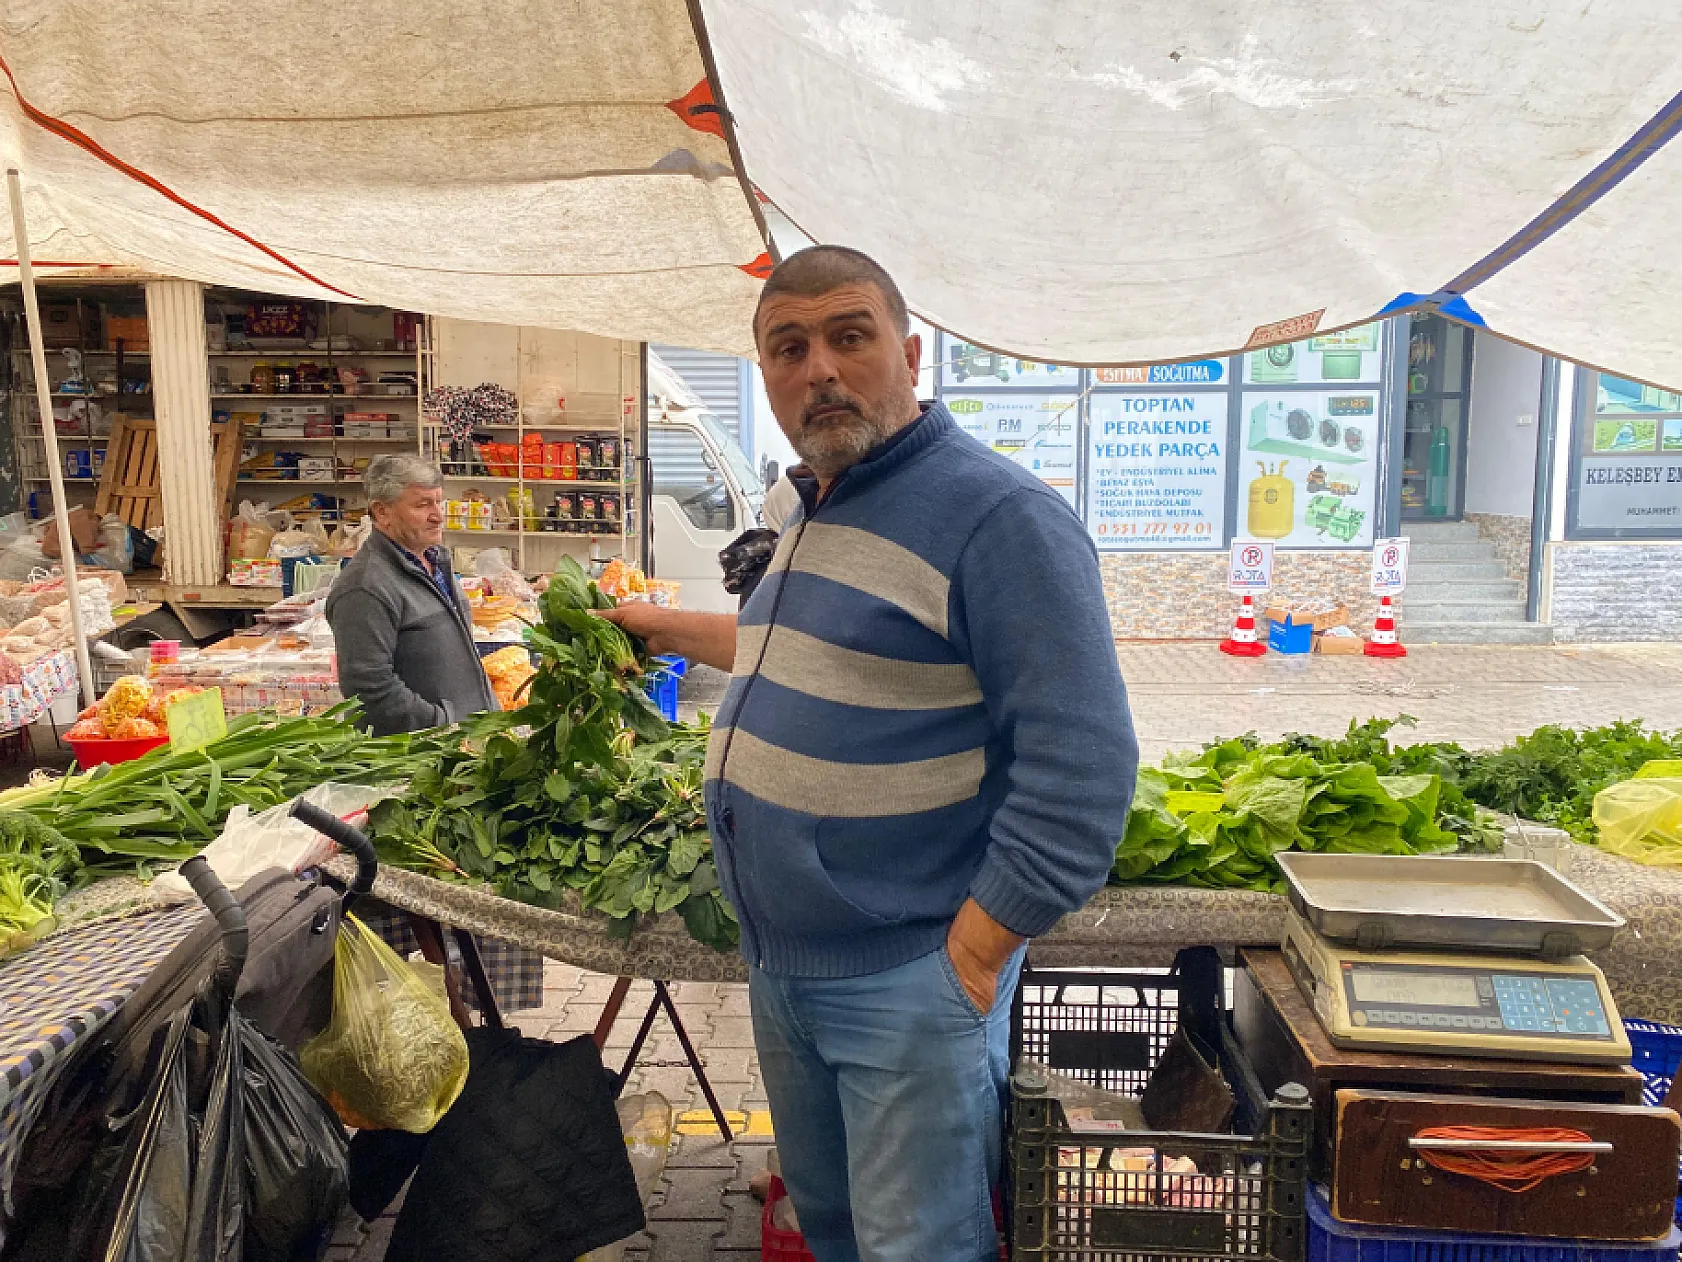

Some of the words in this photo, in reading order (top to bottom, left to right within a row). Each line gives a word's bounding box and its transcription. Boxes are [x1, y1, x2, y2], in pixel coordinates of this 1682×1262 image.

[1122, 397, 1195, 413] TOPTAN
[1104, 420, 1212, 435] PERAKENDE
[1095, 443, 1152, 458] YEDEK
[1159, 442, 1220, 460] PARÇA
[1586, 466, 1662, 486] KELEŞBEY
[1097, 523, 1107, 534] 0
[1144, 522, 1168, 534] 777
[1173, 522, 1190, 534] 97
[1195, 522, 1212, 534] 01
